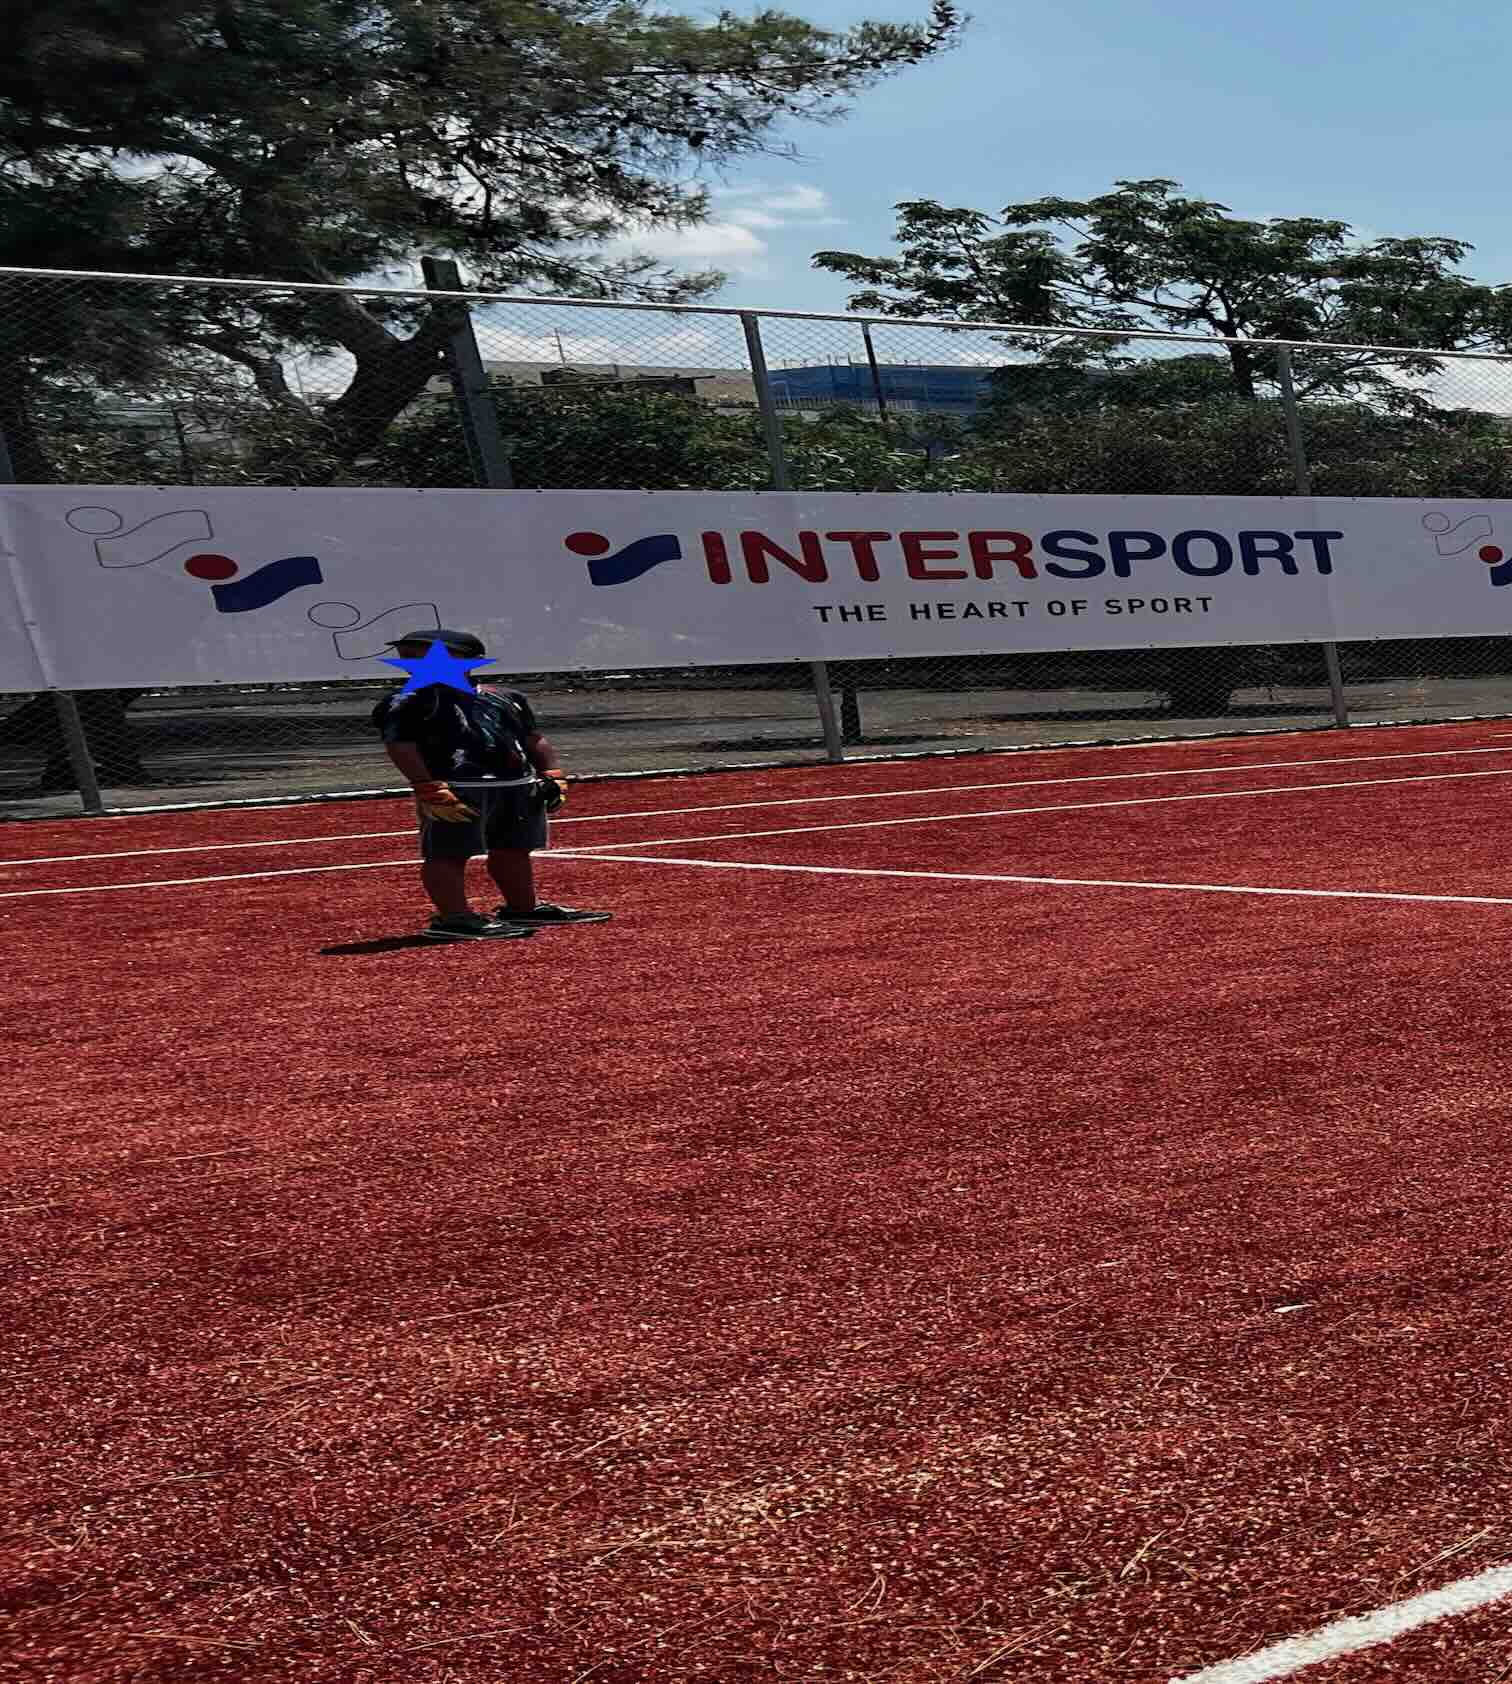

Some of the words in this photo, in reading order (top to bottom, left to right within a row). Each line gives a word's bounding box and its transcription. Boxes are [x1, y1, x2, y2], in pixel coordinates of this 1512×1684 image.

[701, 530, 1344, 585] INTERSPORT
[813, 604, 888, 623] THE
[909, 601, 1028, 620] HEART
[1047, 600, 1088, 616] OF
[1104, 597, 1213, 615] SPORT
